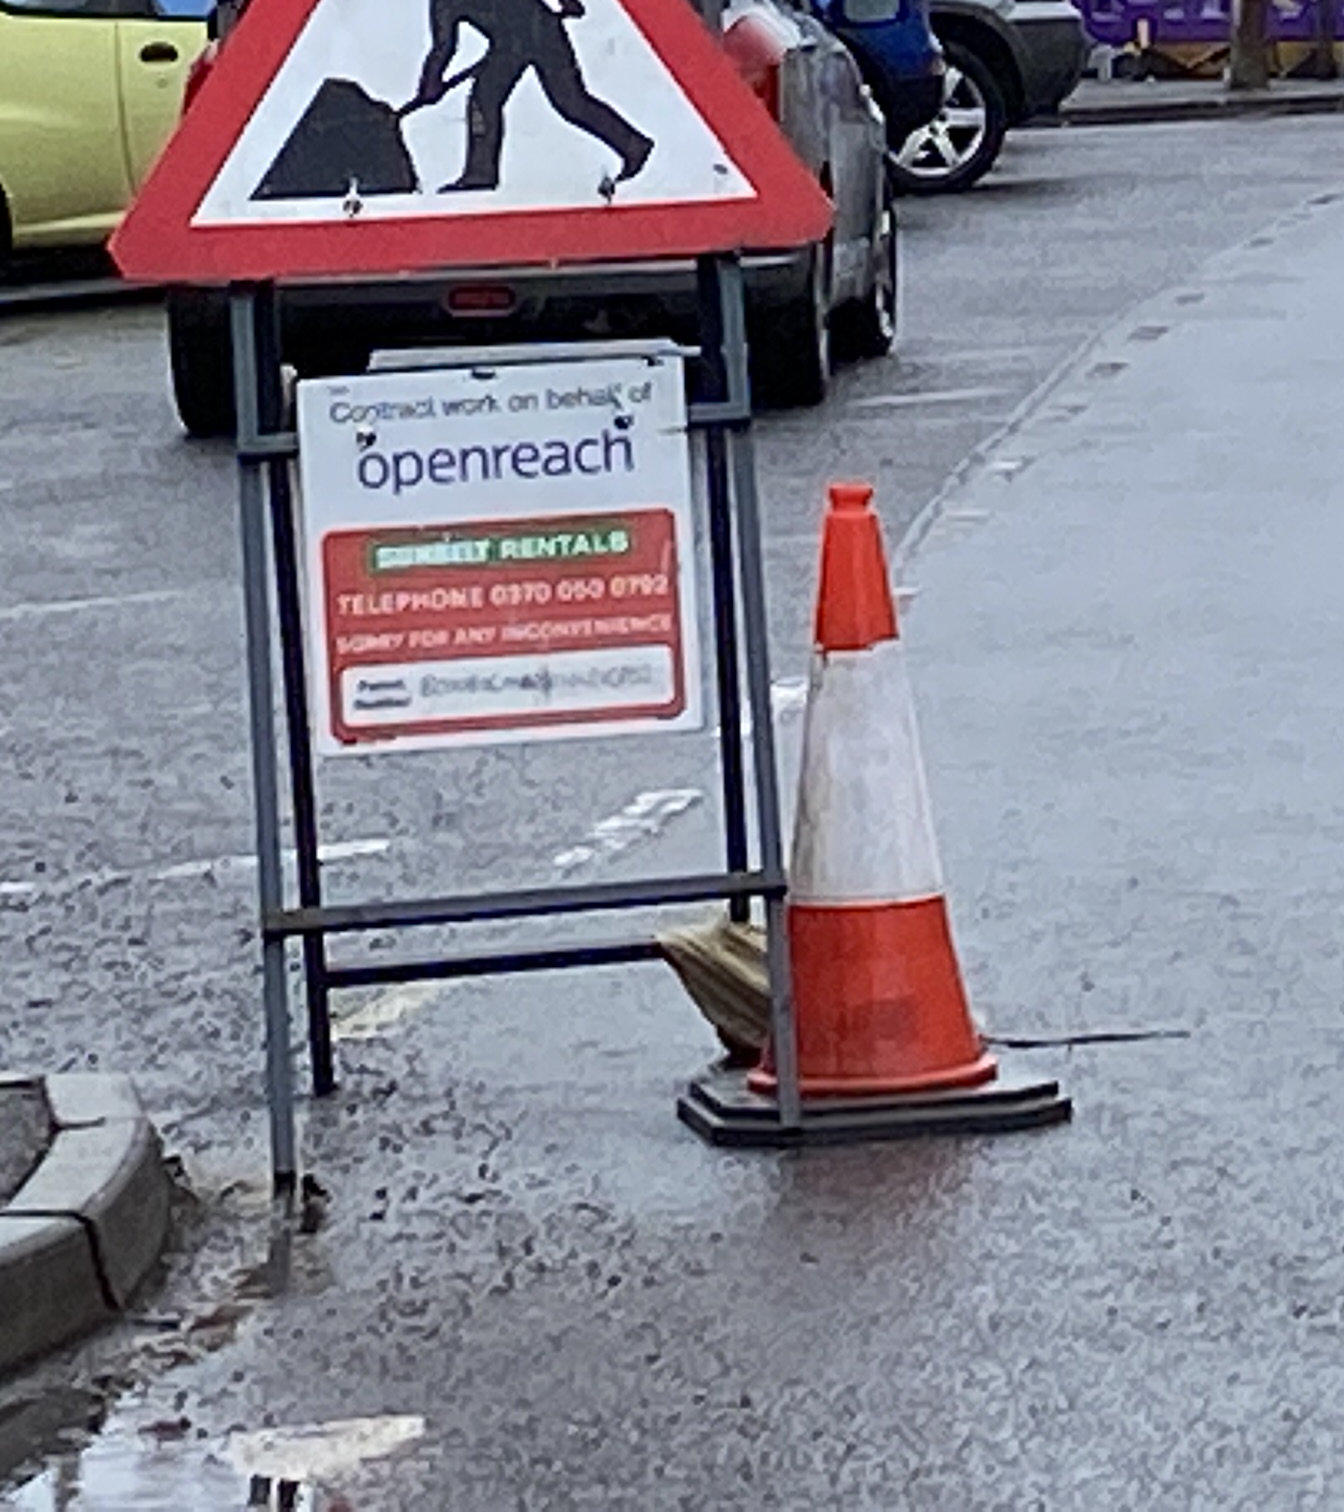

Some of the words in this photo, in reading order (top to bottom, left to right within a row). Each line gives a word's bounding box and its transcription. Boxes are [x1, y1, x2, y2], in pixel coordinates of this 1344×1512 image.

[330, 397, 436, 423] Contract
[442, 394, 499, 416] work
[507, 396, 538, 413] on
[546, 385, 622, 410] behalf
[627, 381, 652, 404] of
[357, 429, 635, 495] openreach
[500, 530, 629, 559] RENTALS
[337, 586, 484, 615] TELEPHONE
[408, 629, 450, 648] FOR
[454, 626, 497, 645] ANY
